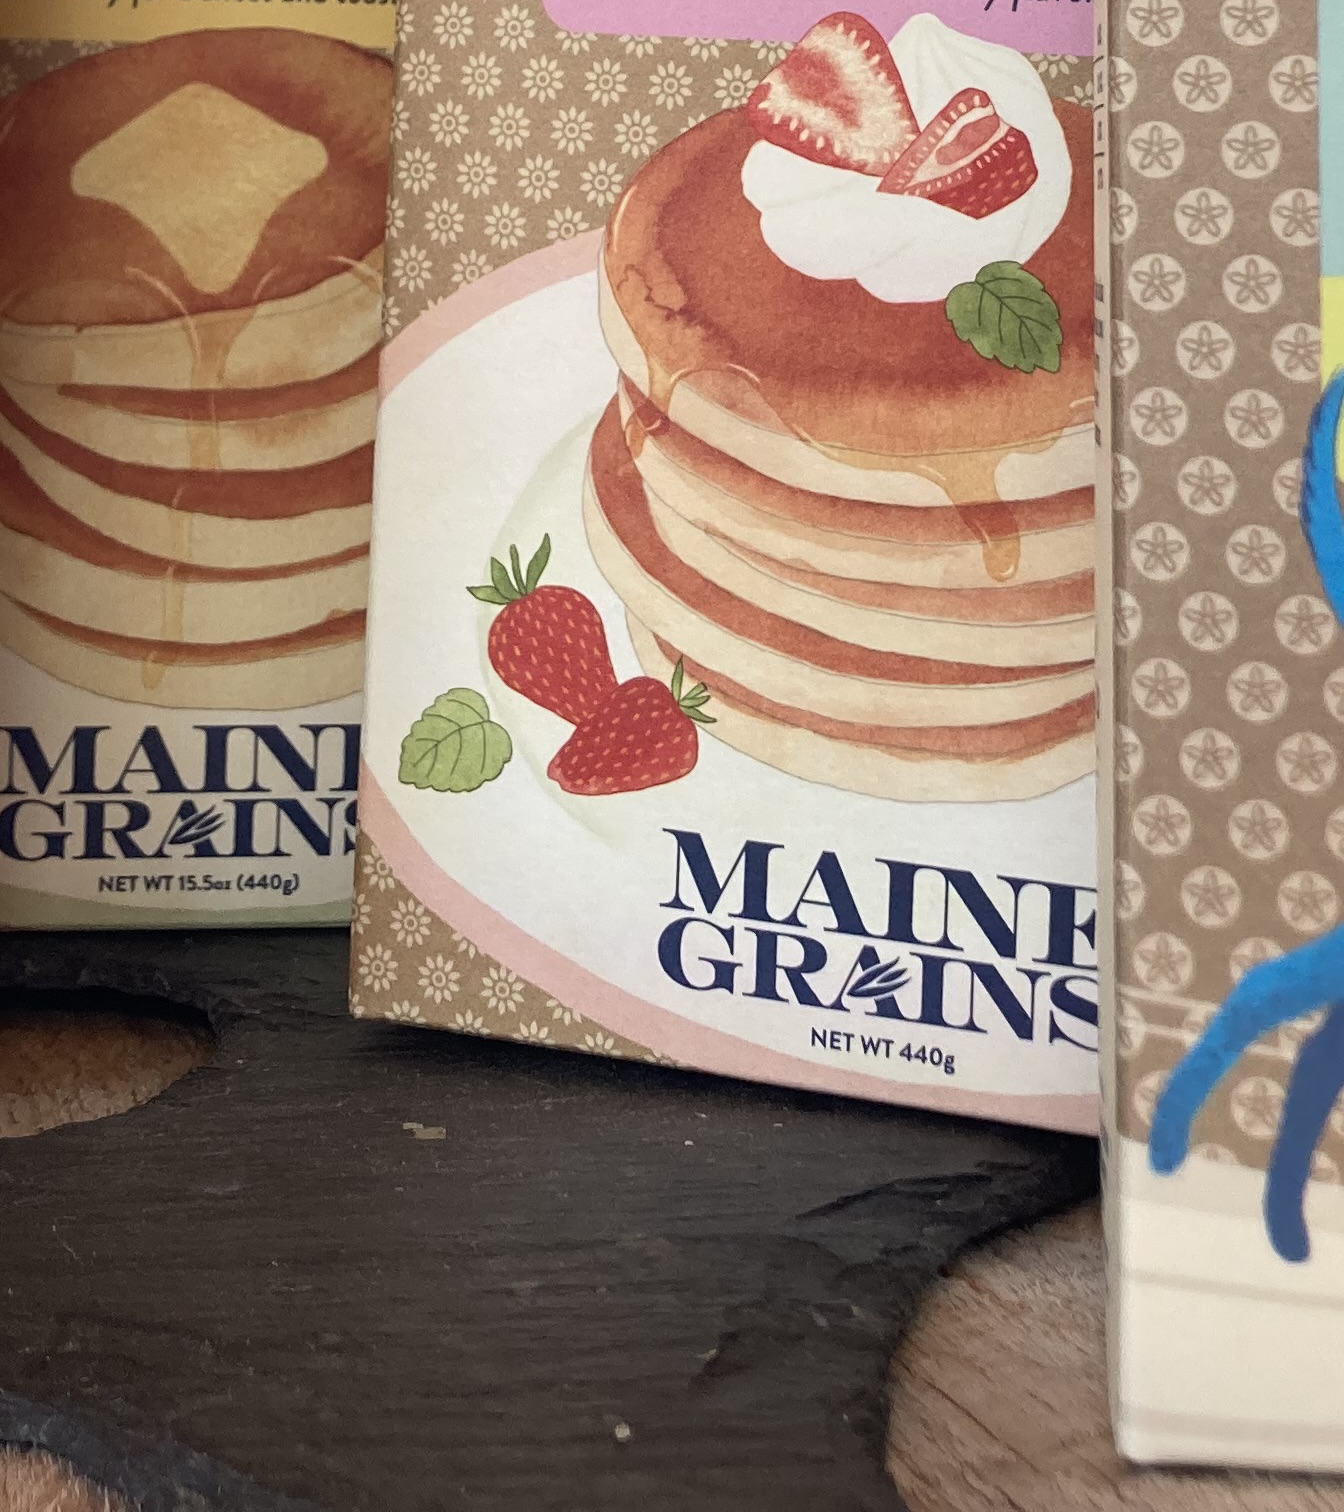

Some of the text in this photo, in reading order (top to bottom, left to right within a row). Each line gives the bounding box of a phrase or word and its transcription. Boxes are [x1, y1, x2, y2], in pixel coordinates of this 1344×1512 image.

[97, 872, 300, 896] NET WT 15.5oz (440g)
[810, 1026, 957, 1076] NET WT 440g
